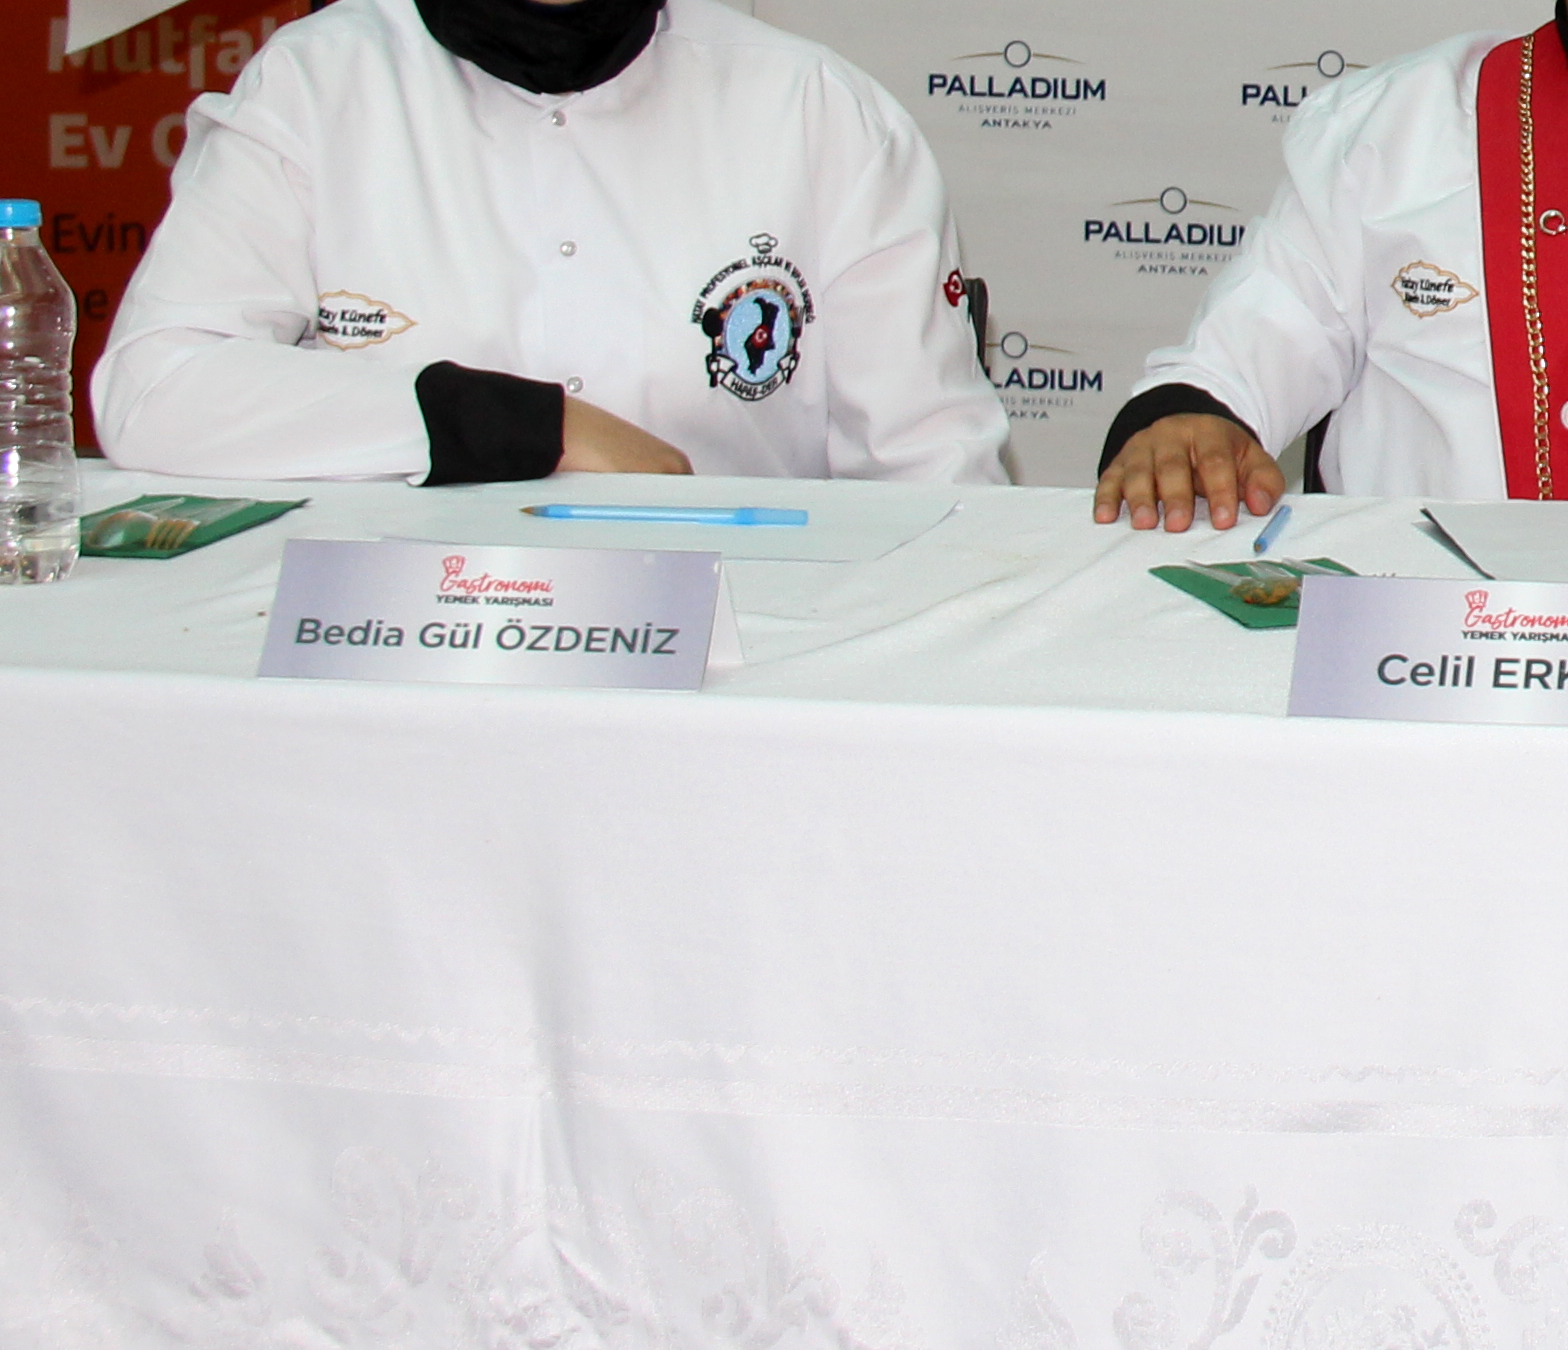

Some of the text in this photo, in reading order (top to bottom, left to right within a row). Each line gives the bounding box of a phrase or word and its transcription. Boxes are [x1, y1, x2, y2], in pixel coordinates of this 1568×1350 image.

[47, 14, 277, 89] Mutfa
[929, 74, 1105, 100] PALLADIUM
[48, 113, 132, 169] Ev
[440, 570, 554, 594] Gastronomi
[436, 594, 554, 607] YEMEK YARIŞMASI
[295, 618, 680, 654] Bedia Gül ÖZDENİZ
[1462, 630, 1507, 641] YEMEK
[1377, 654, 1474, 687] Celil
